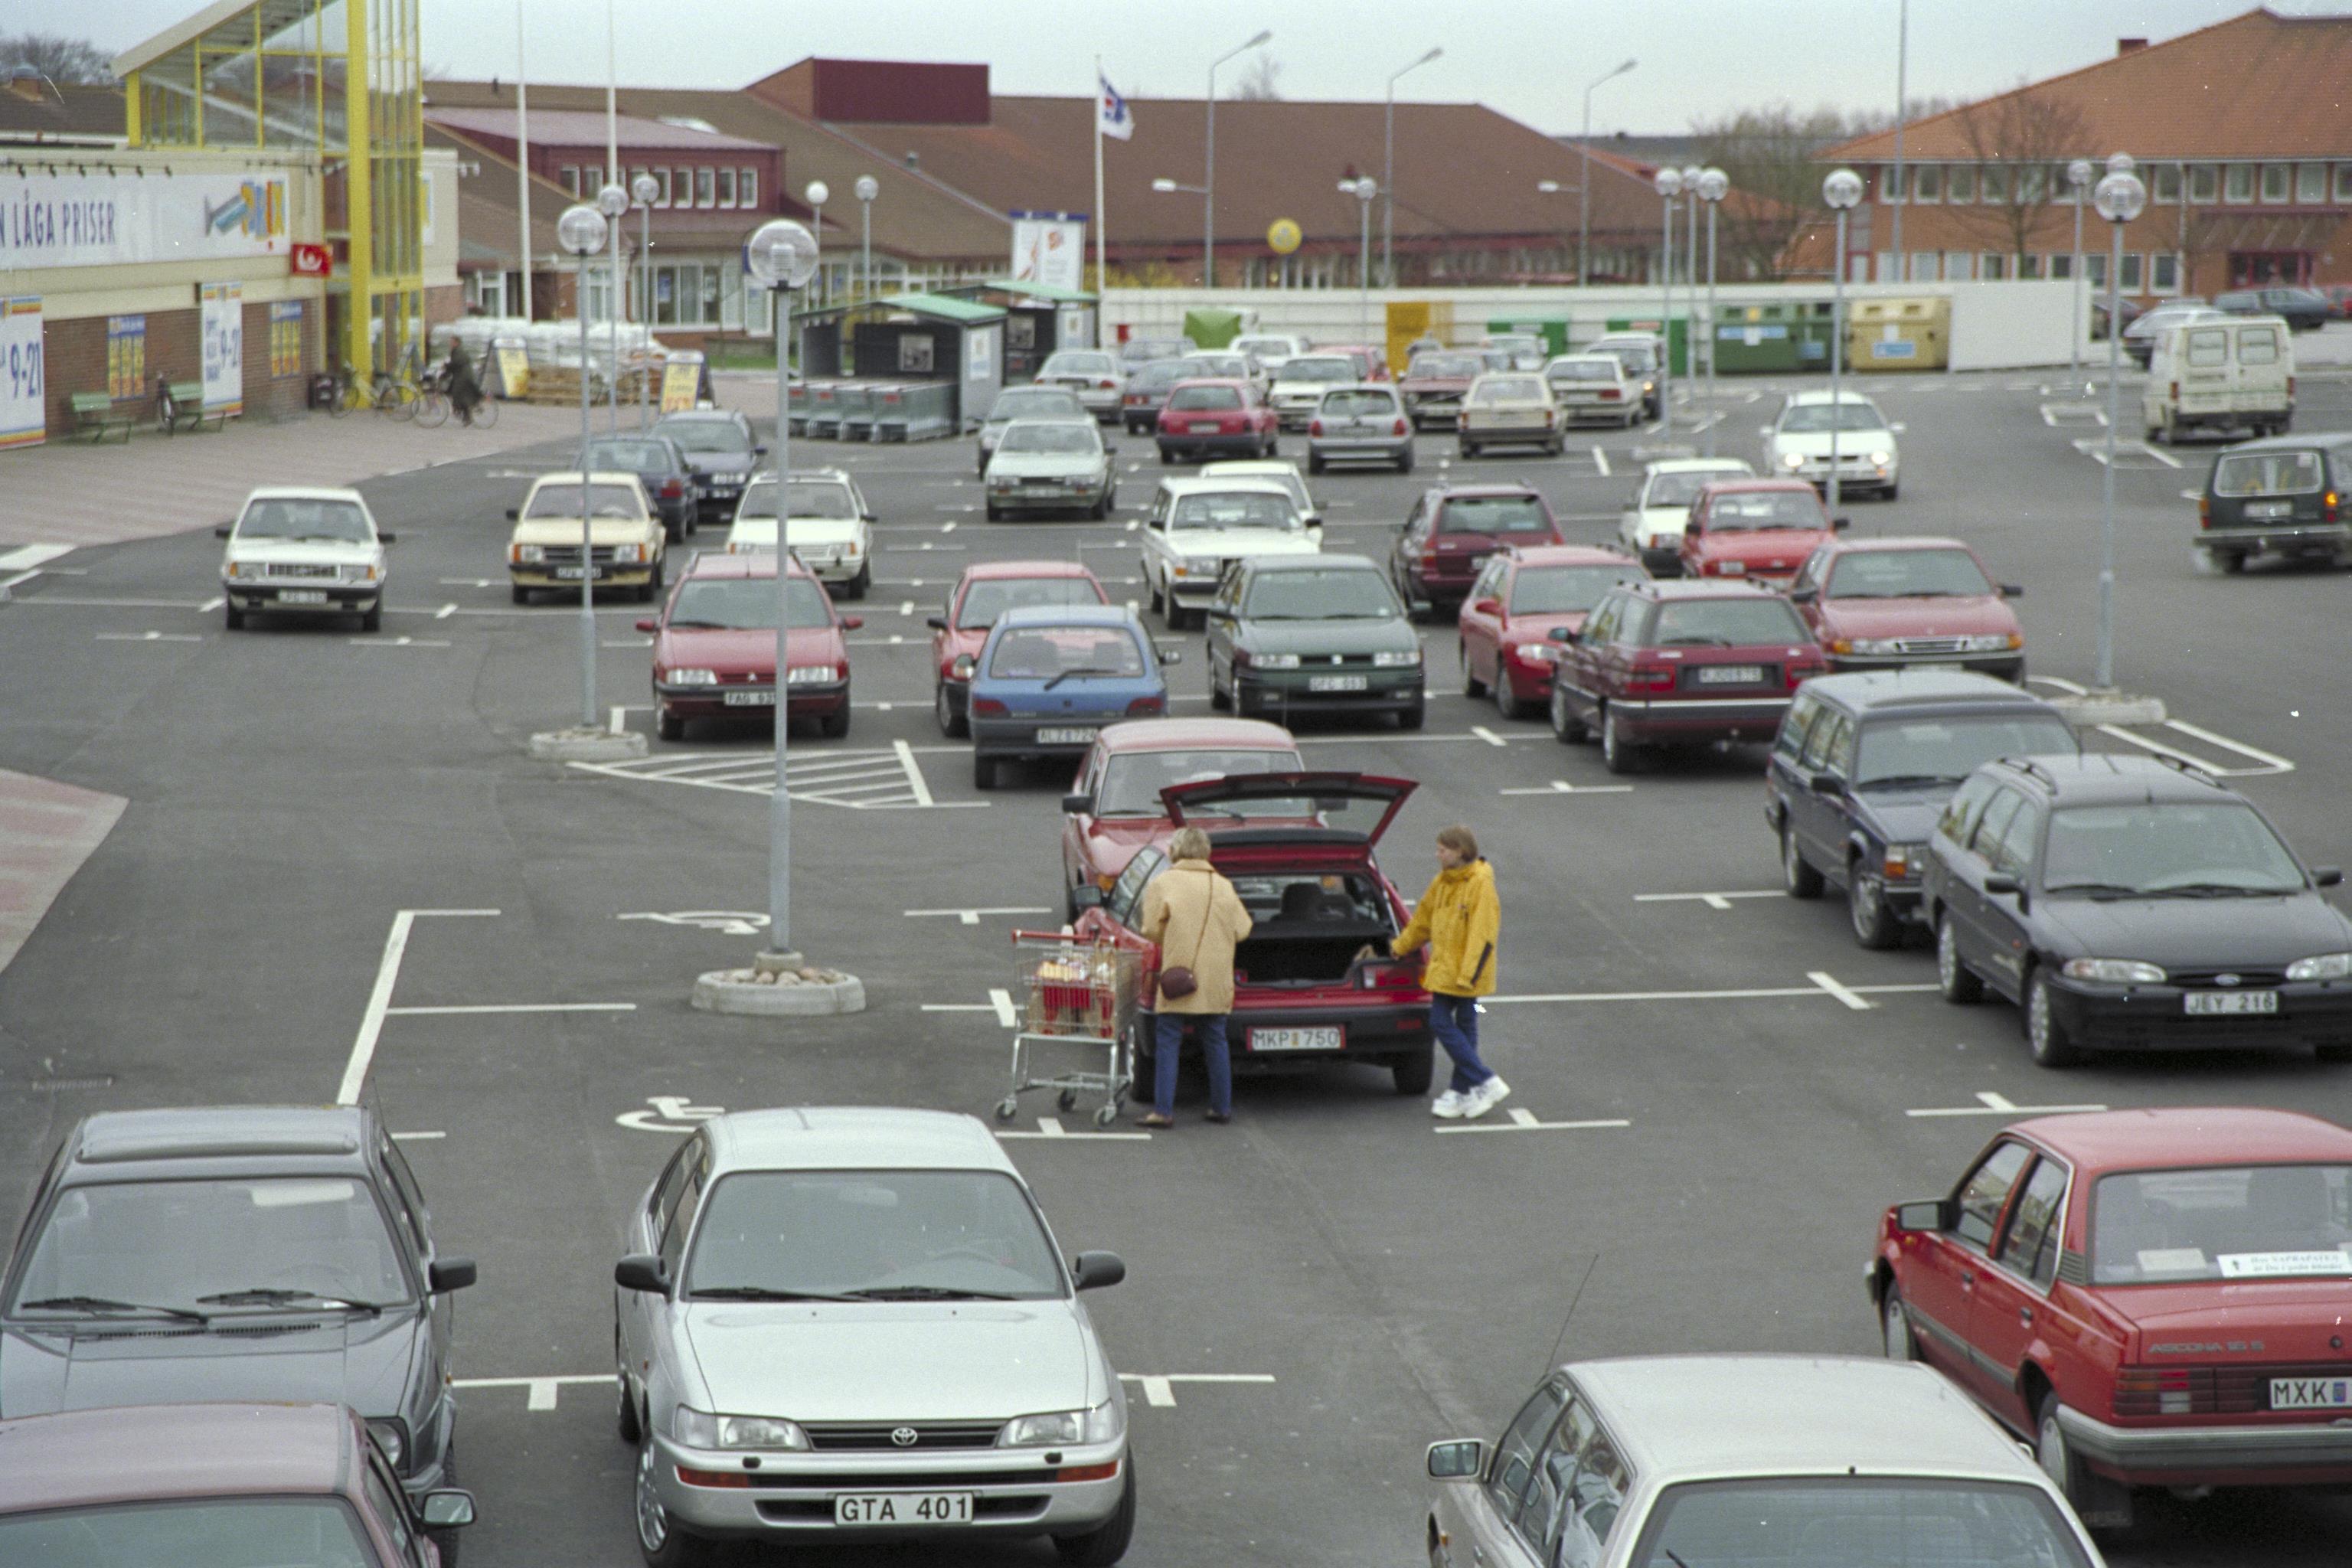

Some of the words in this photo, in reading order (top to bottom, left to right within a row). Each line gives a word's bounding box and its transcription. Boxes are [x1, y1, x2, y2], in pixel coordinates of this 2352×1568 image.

[14, 188, 56, 248] LÅGA
[62, 201, 116, 246] PRISER
[10, 341, 41, 399] 9-21
[1253, 1031, 1290, 1047] MKP
[1303, 1029, 1340, 1047] 750
[2273, 1380, 2328, 1405] MXK
[841, 1498, 896, 1521] GTA
[916, 1496, 966, 1520] 401
